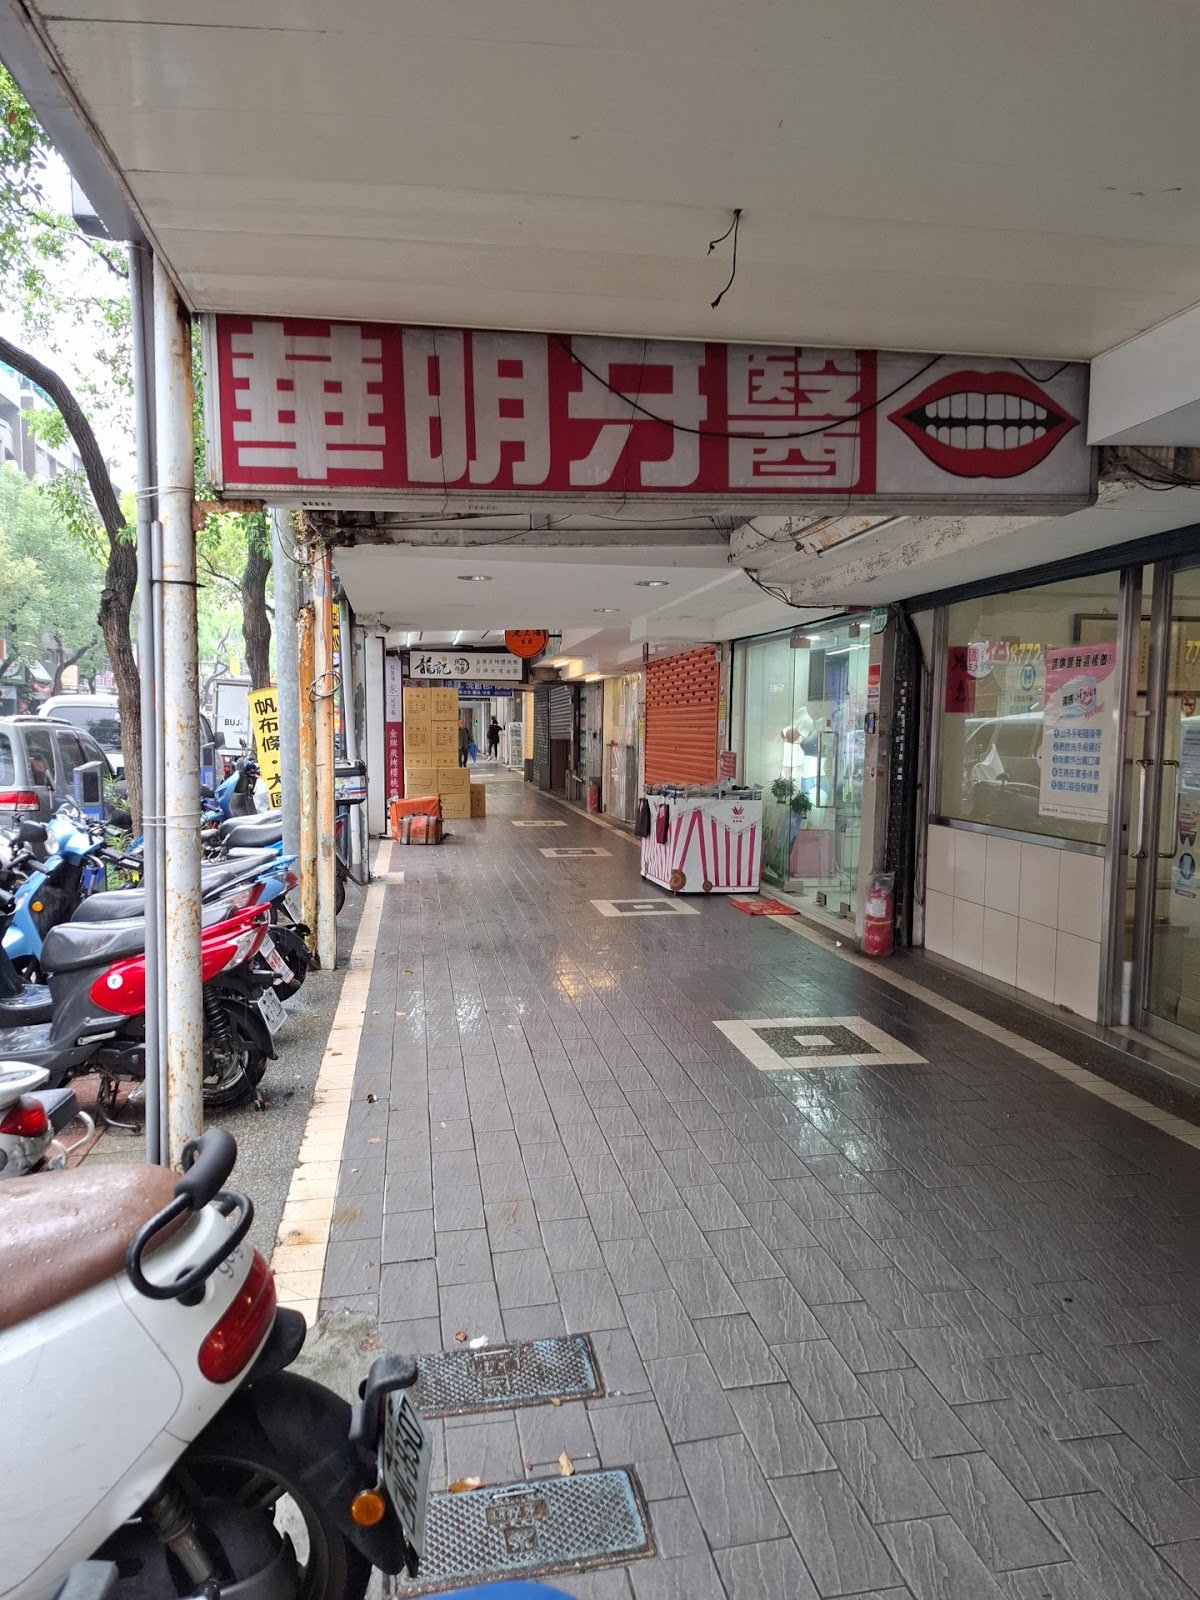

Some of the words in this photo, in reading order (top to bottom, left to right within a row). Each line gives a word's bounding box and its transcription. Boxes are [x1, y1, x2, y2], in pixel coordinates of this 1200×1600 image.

[230, 321, 861, 489] 華明牙醫
[415, 654, 452, 675] 龍記
